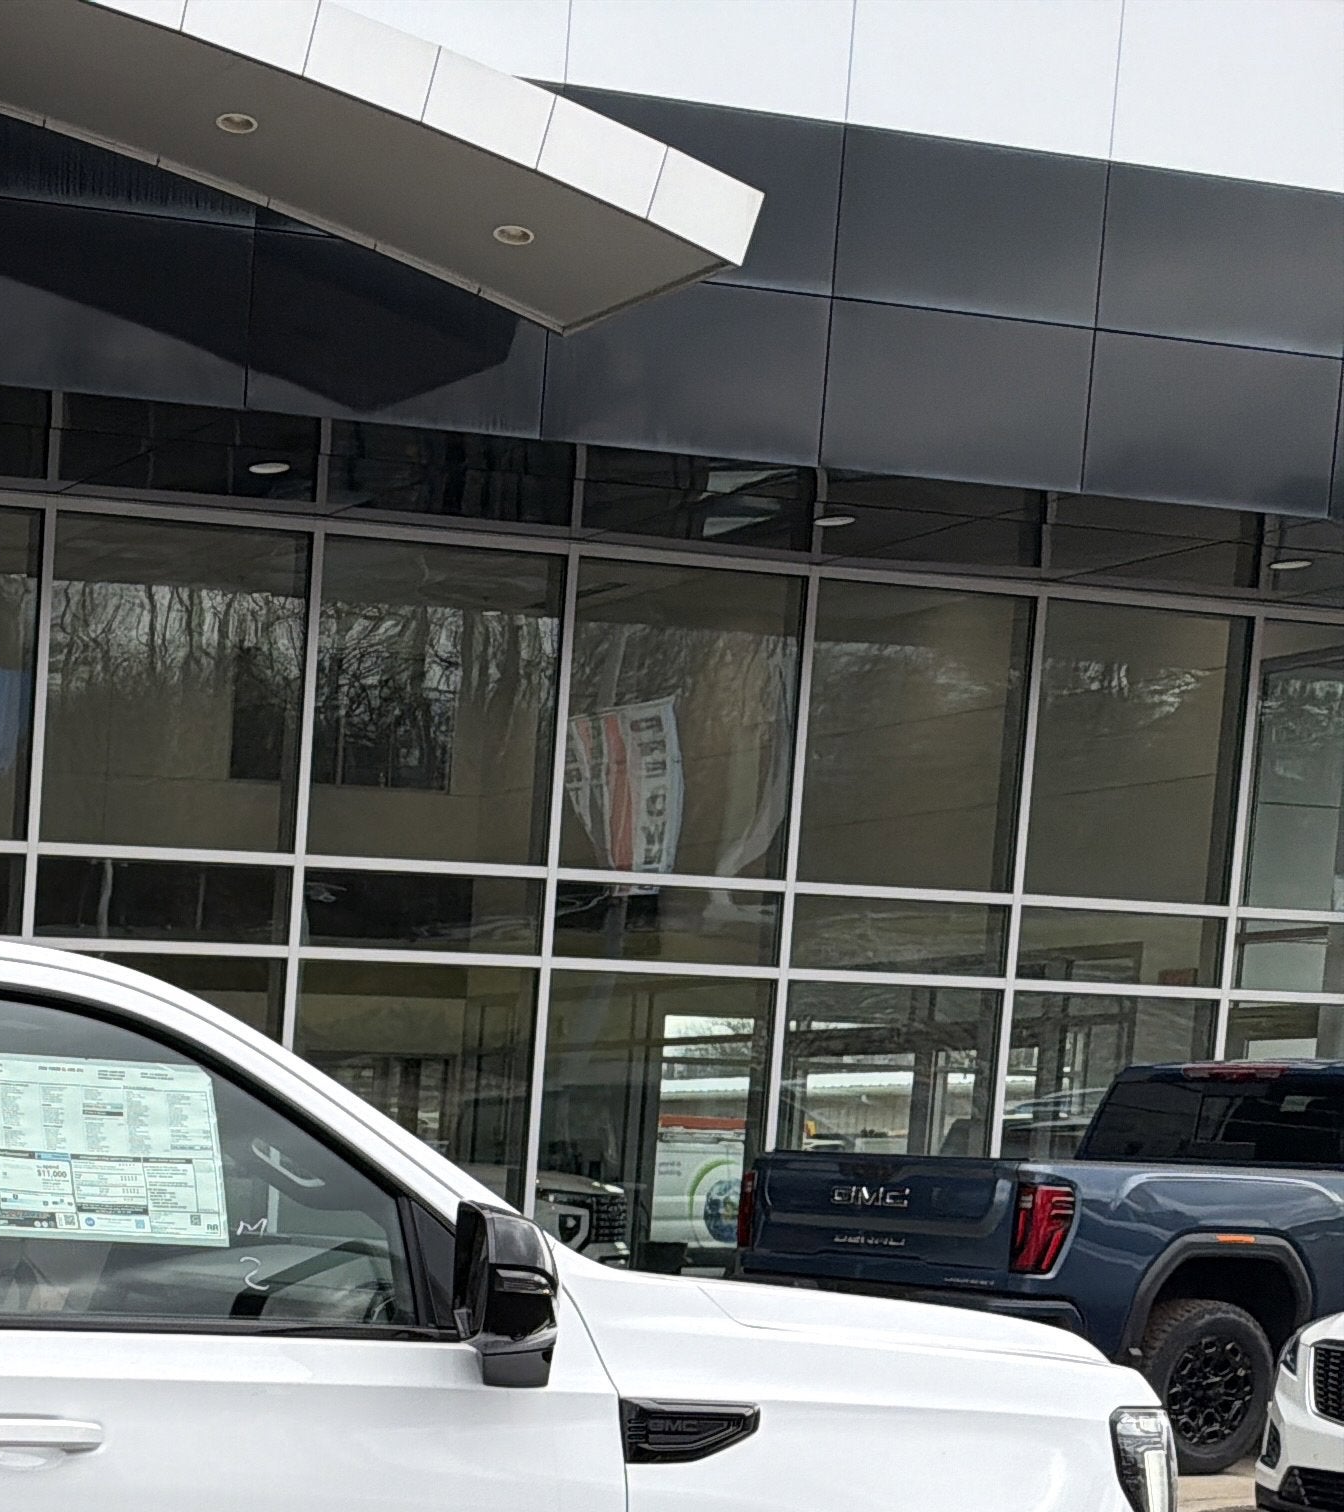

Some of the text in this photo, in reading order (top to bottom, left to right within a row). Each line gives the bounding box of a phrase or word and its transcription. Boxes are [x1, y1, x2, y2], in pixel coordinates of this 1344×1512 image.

[36, 1169, 67, 1178] $11,000
[830, 1185, 911, 1208] GMC
[649, 1420, 698, 1431] GMC
